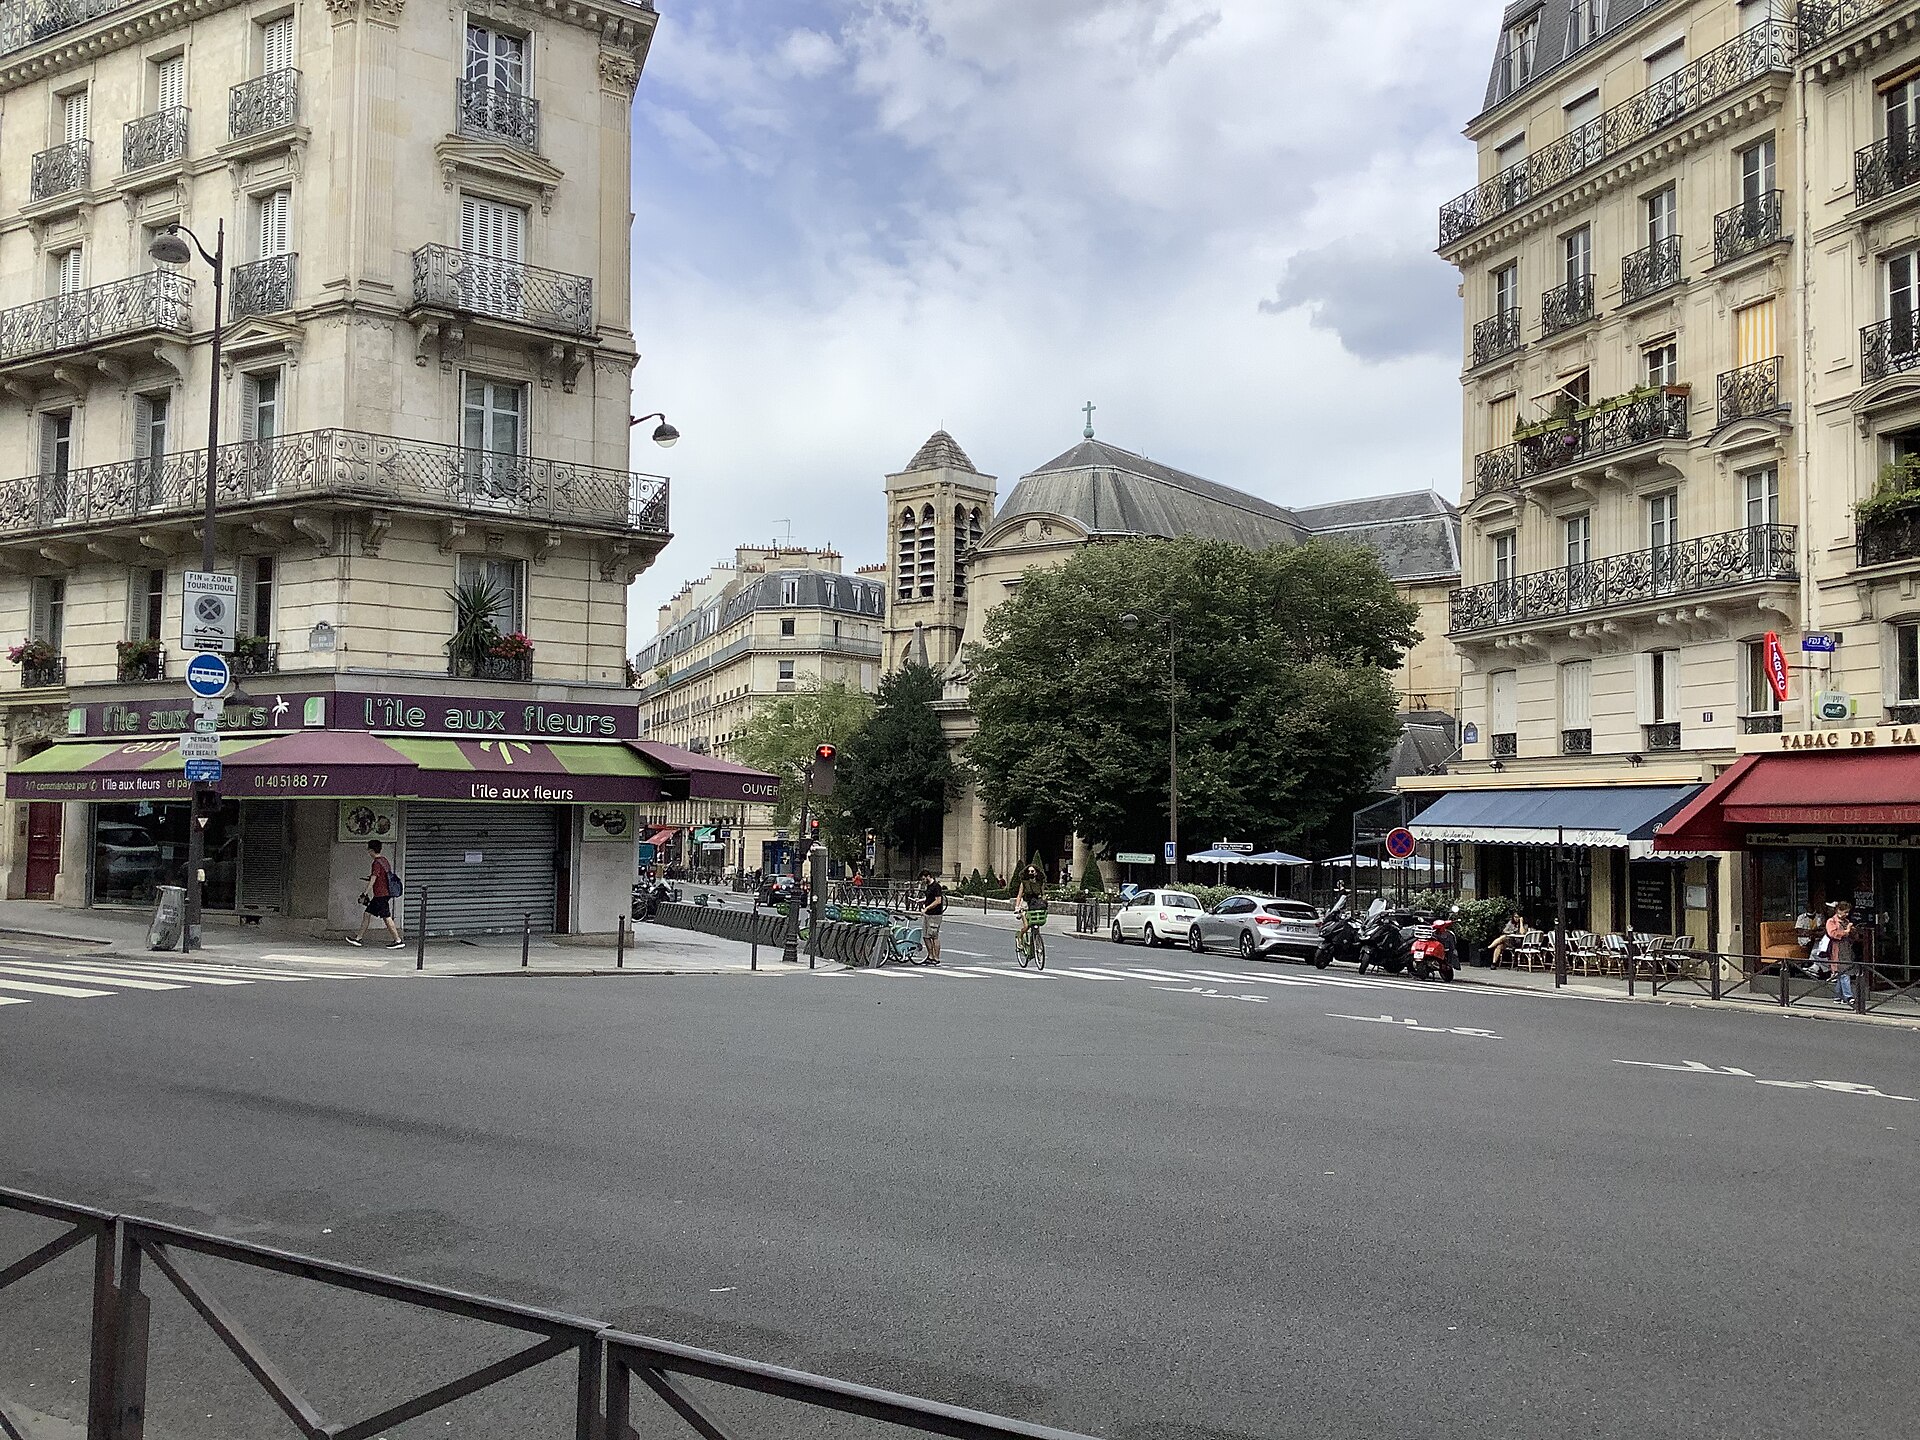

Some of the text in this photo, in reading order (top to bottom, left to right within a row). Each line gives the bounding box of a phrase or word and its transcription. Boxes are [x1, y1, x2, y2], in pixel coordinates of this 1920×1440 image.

[211, 576, 232, 584] ZONE
[187, 582, 234, 592] TOURISTIQUE
[1771, 642, 1785, 690] TABAC
[103, 706, 140, 733] l'île
[148, 709, 190, 731] aux
[364, 698, 617, 735] l'île aux fleurs
[1781, 728, 1916, 750] TABAC DE LA
[118, 781, 135, 790] aux
[136, 778, 160, 790] fleurs
[255, 776, 264, 787] 01
[312, 775, 328, 787] 77
[471, 784, 574, 800] l'île aux fleurs
[1799, 809, 1838, 821] TABAC
[1826, 835, 1848, 845] BAR
[1851, 835, 1883, 845] TABAC
